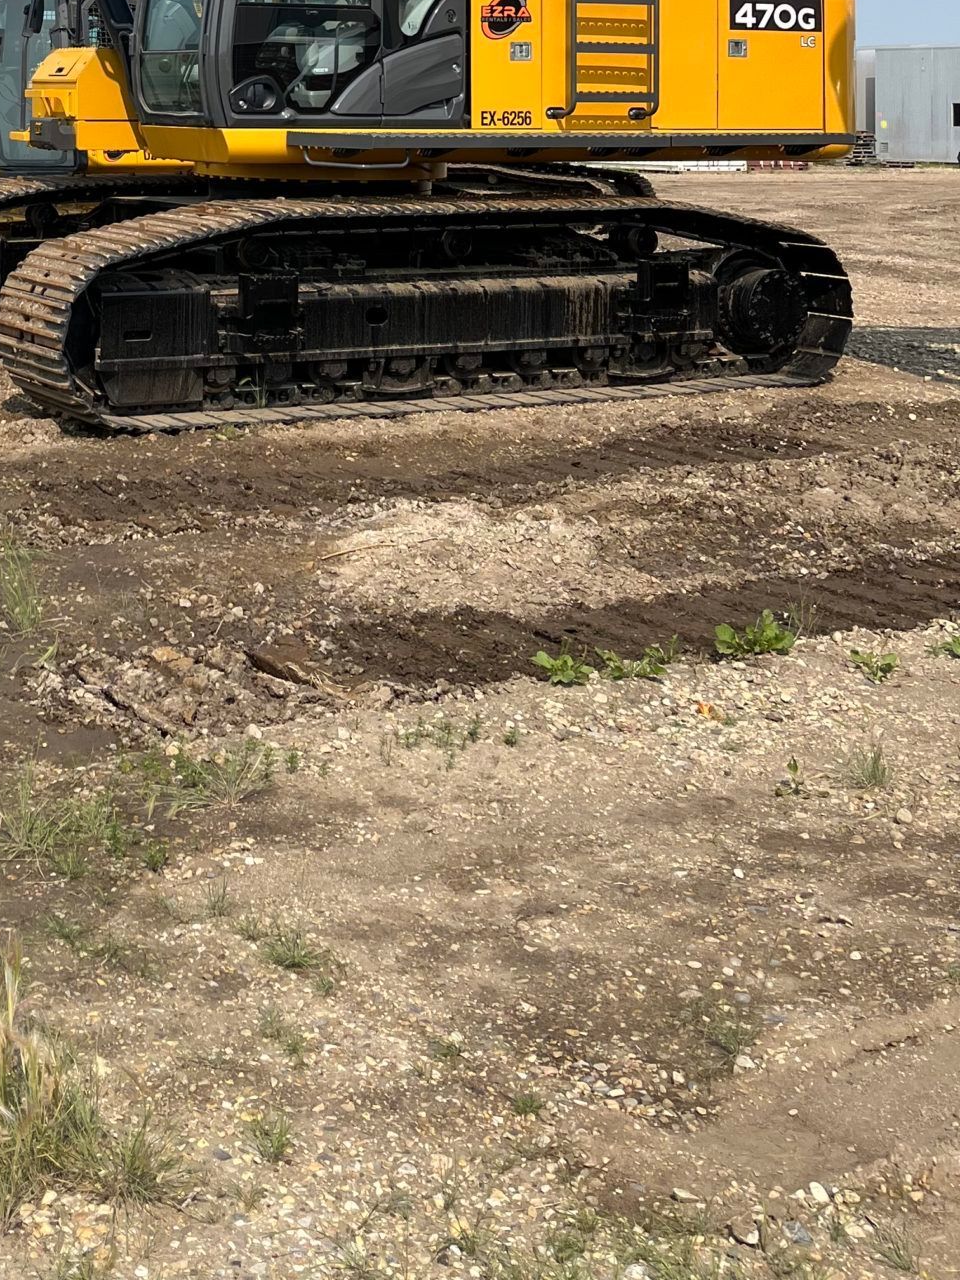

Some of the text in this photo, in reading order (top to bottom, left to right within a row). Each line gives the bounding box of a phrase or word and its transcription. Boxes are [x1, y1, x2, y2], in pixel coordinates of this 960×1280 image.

[482, 5, 531, 18] EZRA
[734, 2, 816, 30] 470G
[800, 36, 816, 47] LC
[481, 111, 532, 126] EX-6256
